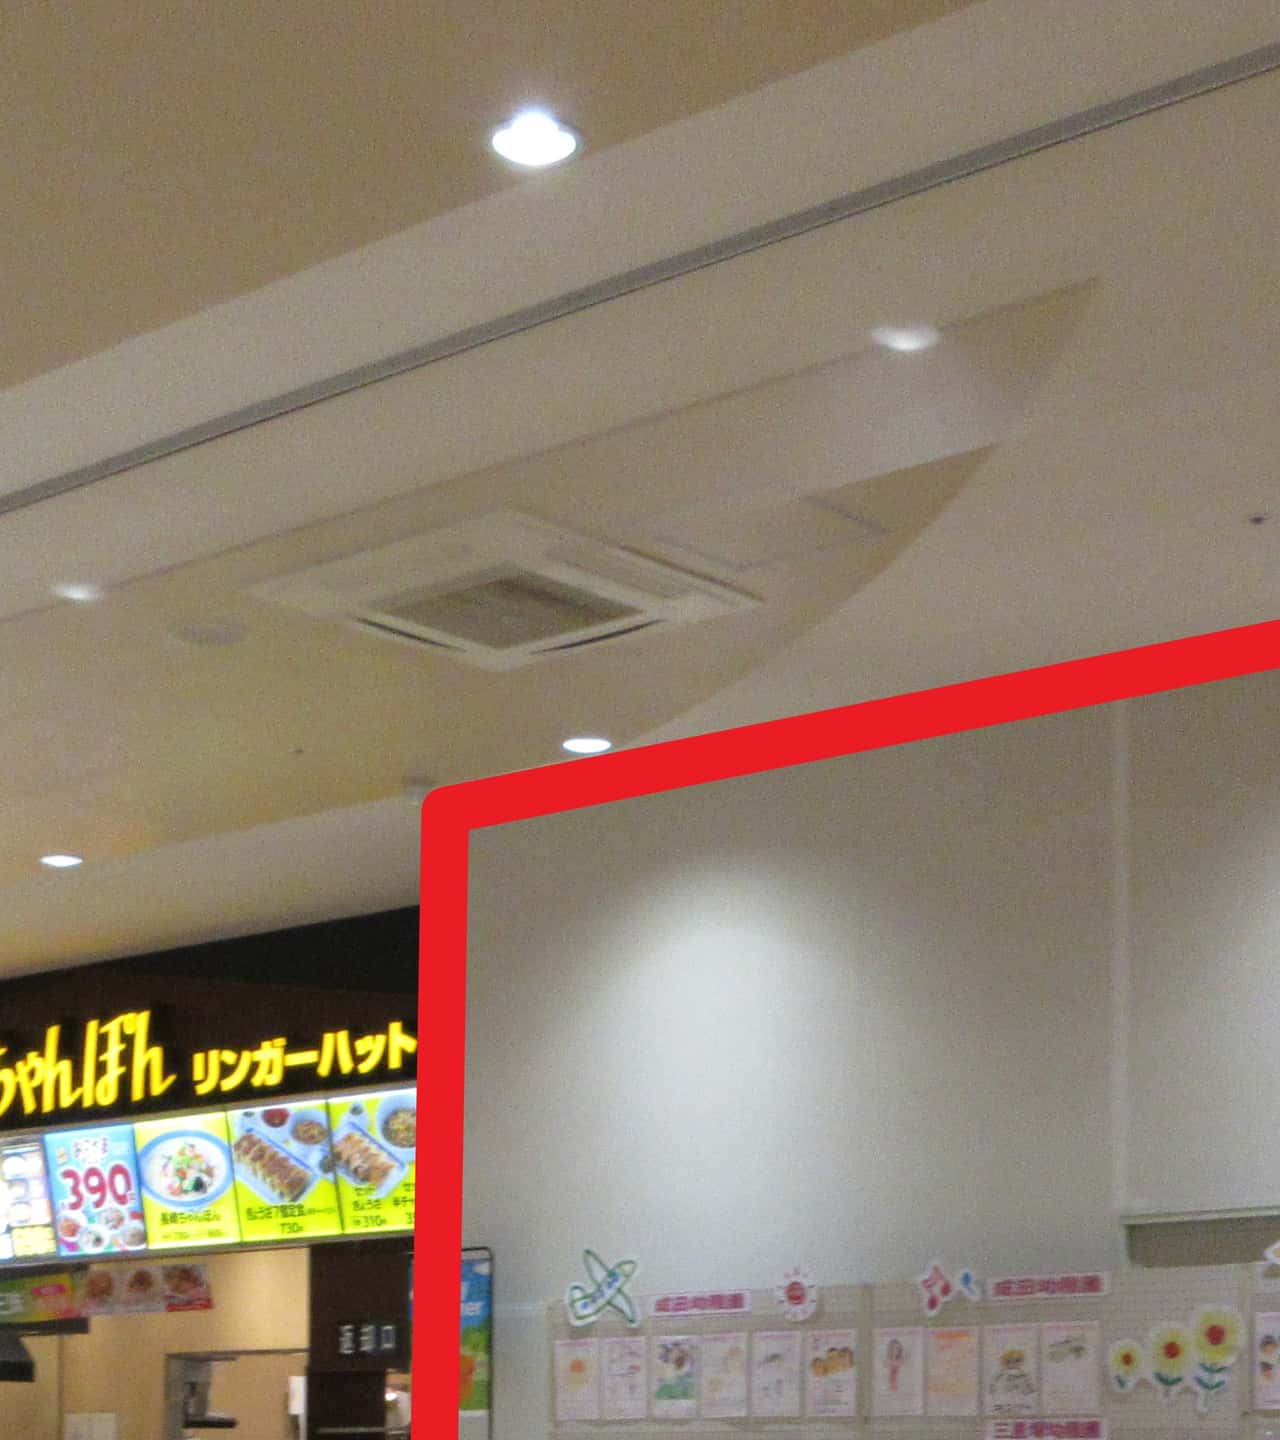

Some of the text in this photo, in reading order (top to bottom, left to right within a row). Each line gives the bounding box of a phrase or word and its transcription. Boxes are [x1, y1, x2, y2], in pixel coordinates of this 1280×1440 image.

[193, 1021, 417, 1096] リンガーハット
